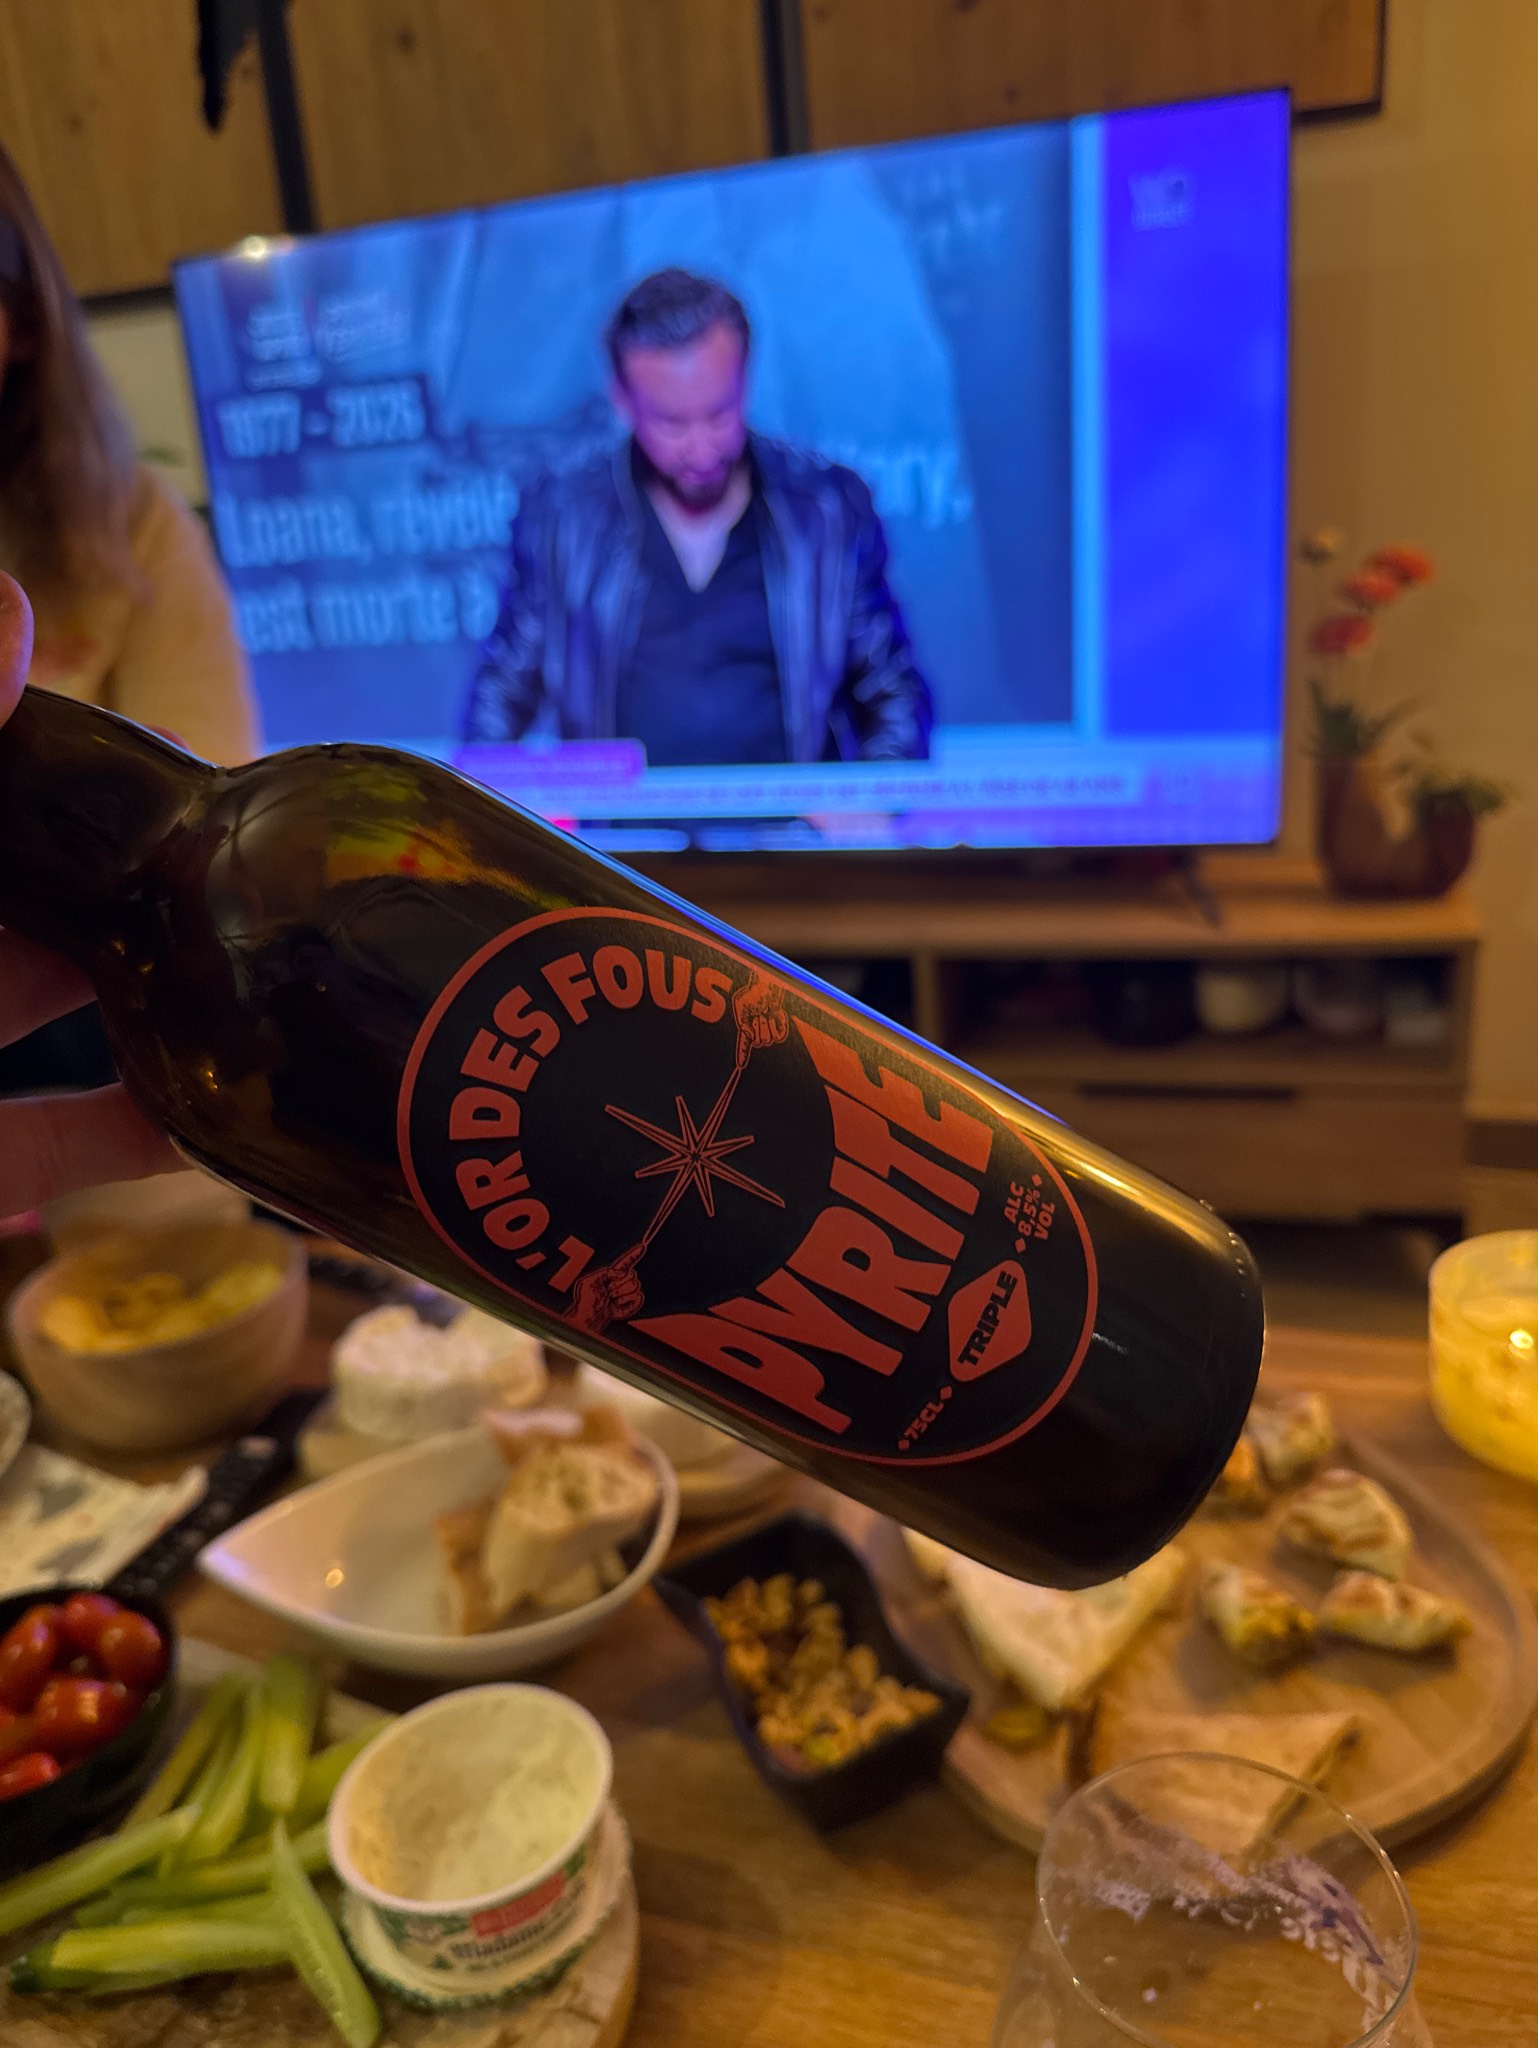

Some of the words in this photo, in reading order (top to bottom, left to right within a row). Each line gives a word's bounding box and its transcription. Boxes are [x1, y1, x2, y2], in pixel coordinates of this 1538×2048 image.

[540, 945, 733, 1026] FOUS
[449, 985, 561, 1140] DES
[455, 1150, 596, 1294] L'OR
[627, 1016, 993, 1435] PYRITE
[1003, 1181, 1024, 1224] ALC
[1018, 1188, 1041, 1236] 8,5%
[1034, 1202, 1055, 1240] VOL
[957, 1270, 1018, 1366] TRIPLE
[904, 1401, 944, 1440] 75CL
